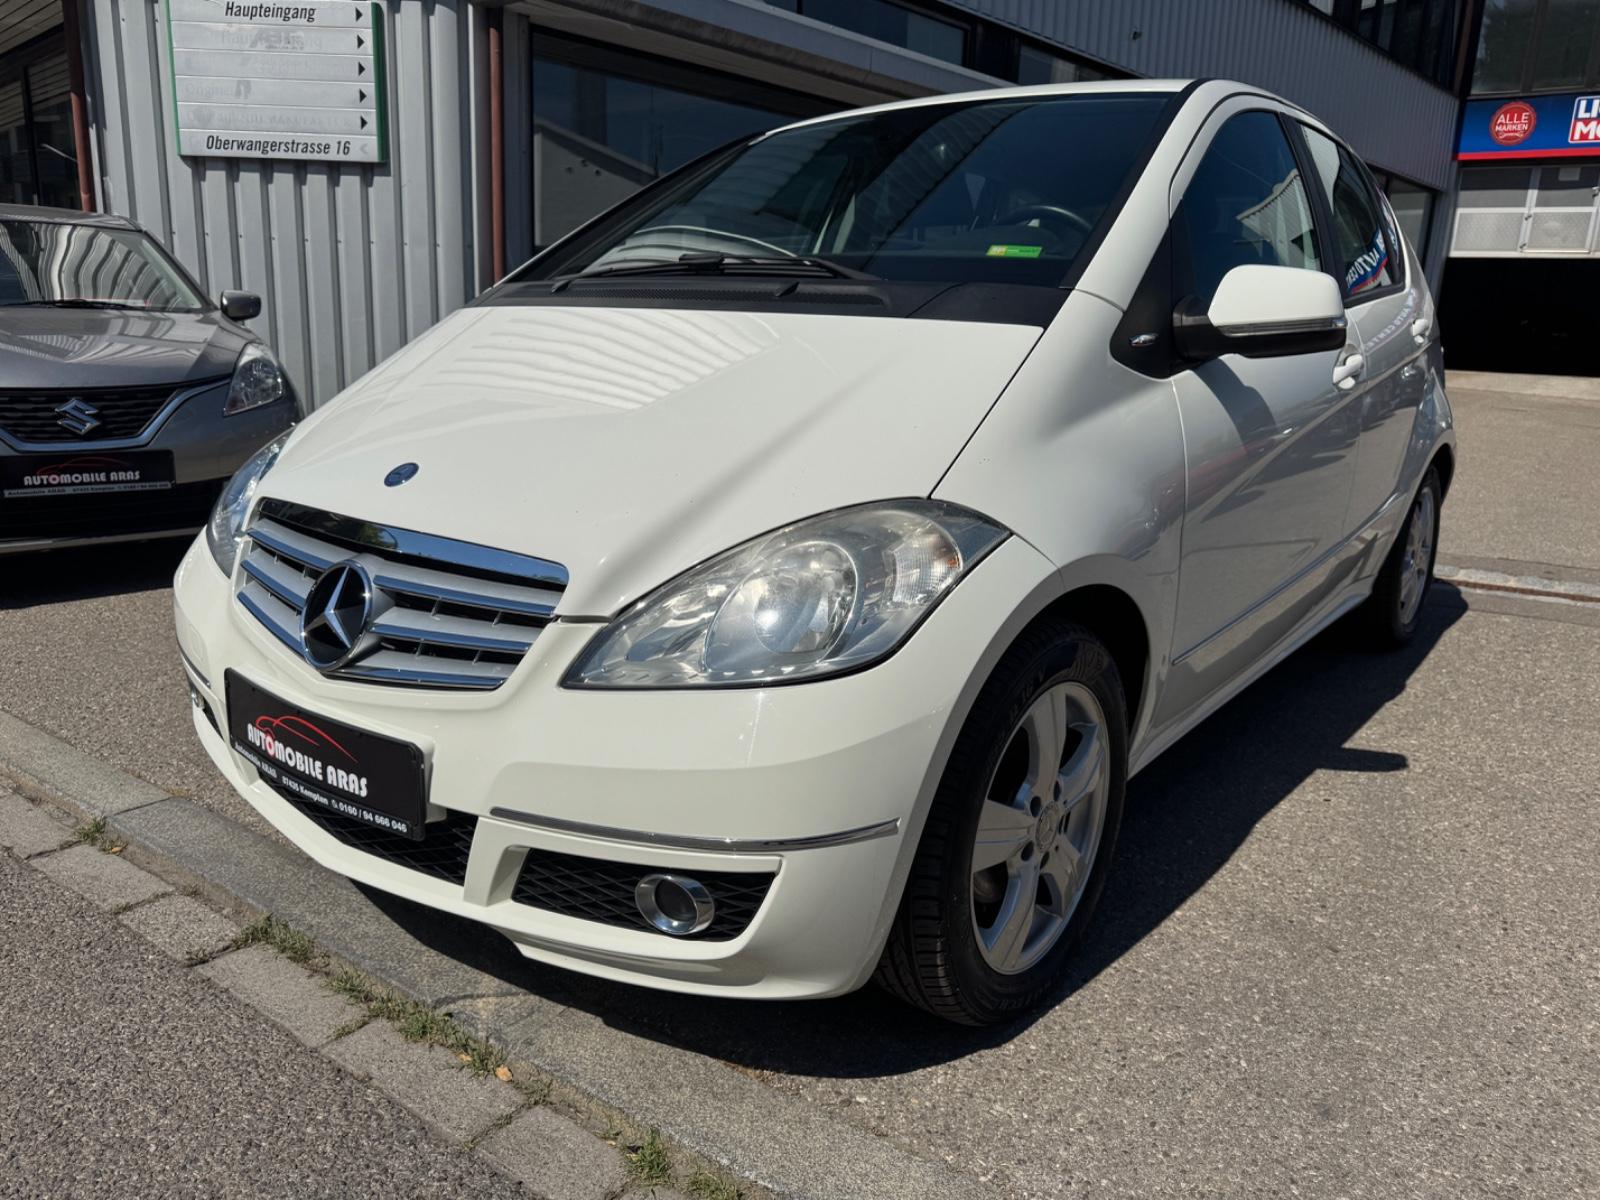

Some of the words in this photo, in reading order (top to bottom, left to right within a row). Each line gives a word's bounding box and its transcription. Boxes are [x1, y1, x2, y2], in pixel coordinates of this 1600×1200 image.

[225, 1, 316, 22] Haupteingang
[1577, 98, 1600, 119] LI
[1496, 112, 1530, 124] ALLE
[1495, 123, 1529, 132] MARKEN
[206, 135, 331, 155] Oberwangerstrasse
[336, 141, 352, 156] 16
[23, 472, 107, 486] AUTOMOBILE
[110, 470, 140, 481] ARAS
[247, 723, 323, 779] AUTOMOBILE
[327, 765, 368, 798] ARAS
[338, 802, 358, 816] 0160
